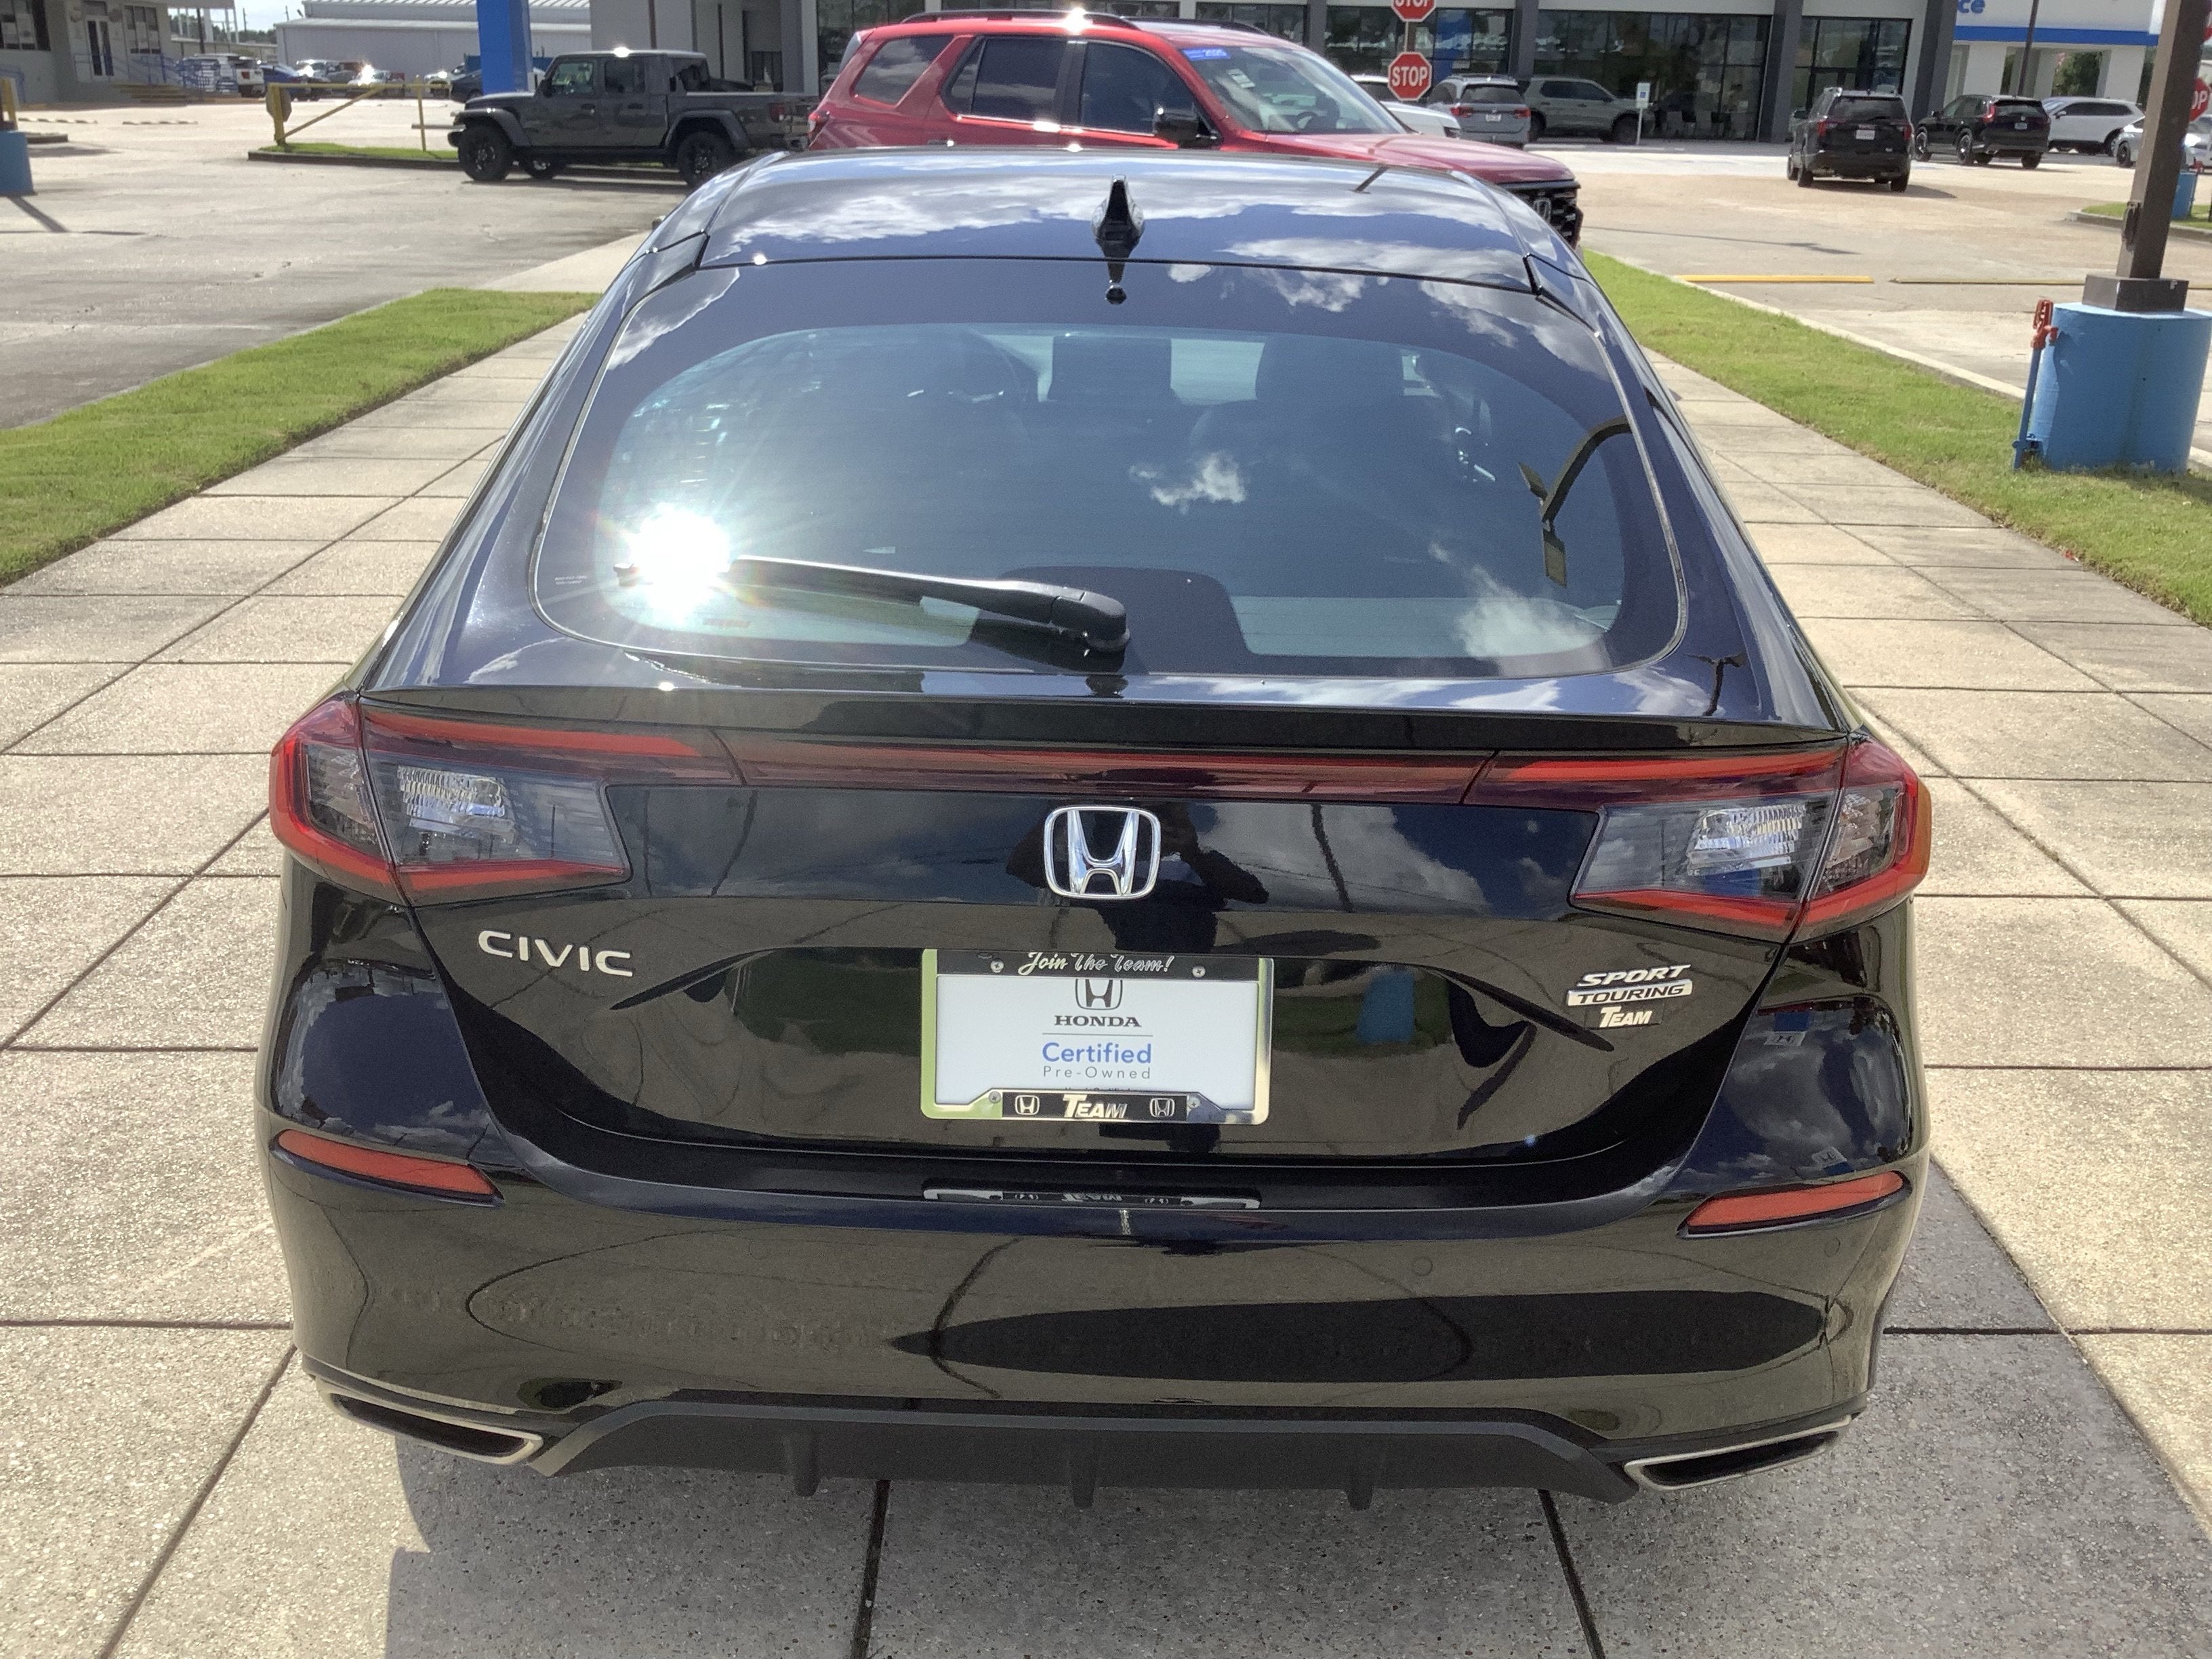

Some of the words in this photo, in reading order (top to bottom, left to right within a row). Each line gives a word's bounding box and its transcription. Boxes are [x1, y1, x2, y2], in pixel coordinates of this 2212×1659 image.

[1391, 66, 1428, 87] STOP
[478, 930, 634, 977] CIVIC
[1017, 951, 1068, 976] Join
[1576, 964, 1692, 987] SPORT
[1576, 983, 1686, 1004] TOURING
[1054, 1015, 1143, 1027] HONDA
[1599, 1006, 1654, 1028] TEAM
[1042, 1042, 1152, 1064] Certified
[1043, 1065, 1151, 1079] Pre-Owned
[1062, 1093, 1128, 1119] TEAM
